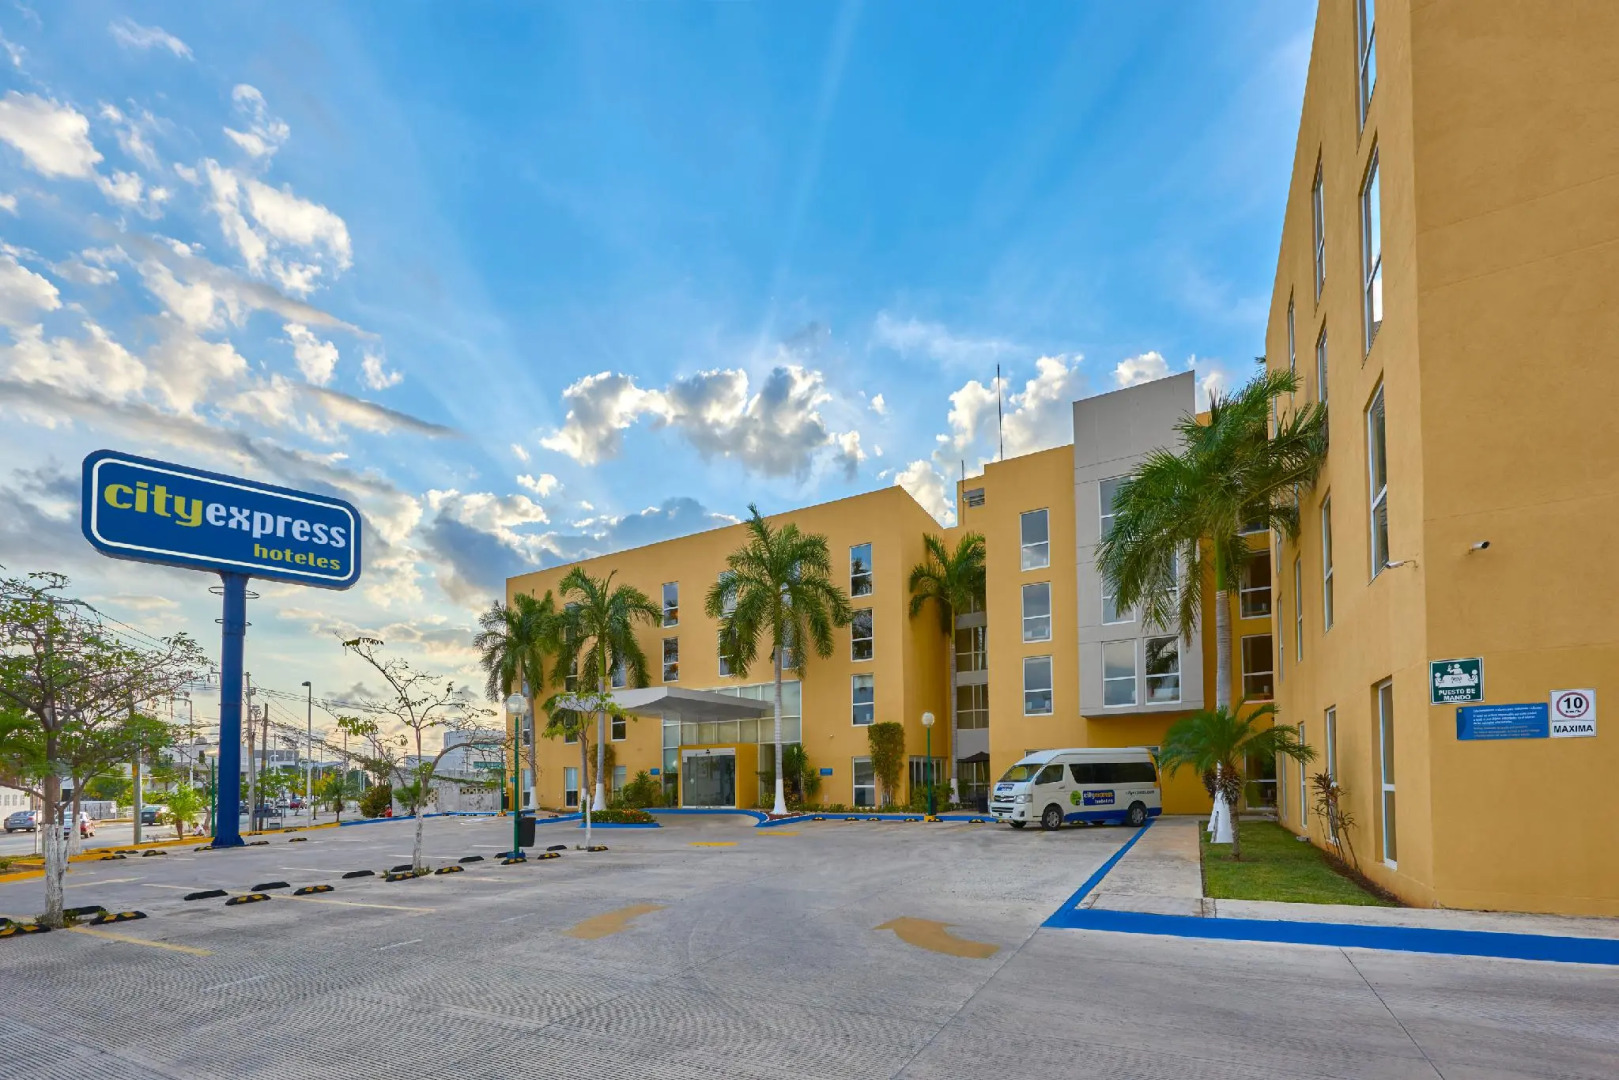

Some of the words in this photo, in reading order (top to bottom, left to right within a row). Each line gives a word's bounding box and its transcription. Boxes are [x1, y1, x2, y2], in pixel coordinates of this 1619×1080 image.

[104, 481, 346, 548] cityexpress
[254, 544, 341, 570] hoteles
[1563, 697, 1583, 709] 10
[1553, 724, 1593, 733] MAXIMA
